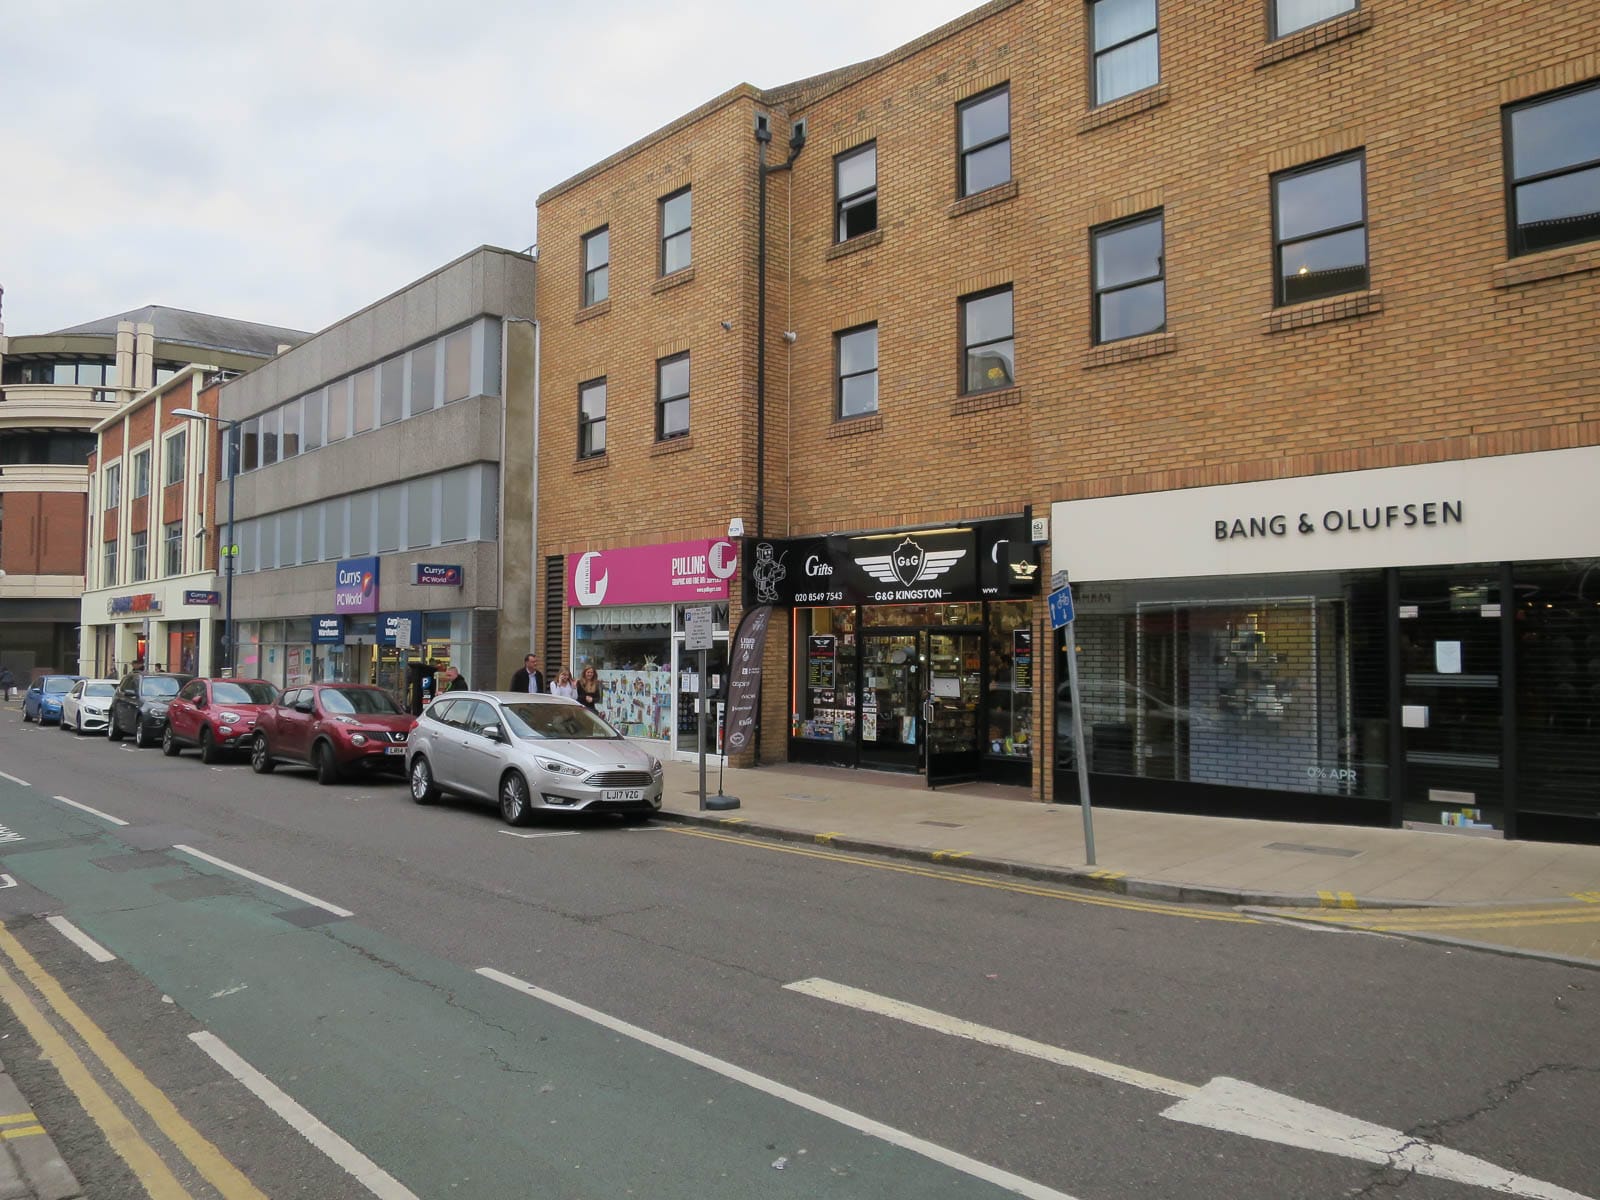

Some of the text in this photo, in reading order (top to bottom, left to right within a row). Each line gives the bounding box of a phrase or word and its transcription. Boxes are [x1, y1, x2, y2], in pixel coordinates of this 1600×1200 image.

[1215, 499, 1463, 541] BANG & OLUFSEN
[805, 555, 834, 576] Gifts
[897, 555, 919, 567] G&G
[424, 566, 446, 575] Currys
[339, 569, 361, 586] Currys
[336, 592, 362, 606] PC World
[795, 591, 843, 602] 020 8549 7543
[875, 588, 942, 601] G&G KINGSTON
[1307, 766, 1357, 781] 0% APR
[606, 791, 623, 799] LJ17
